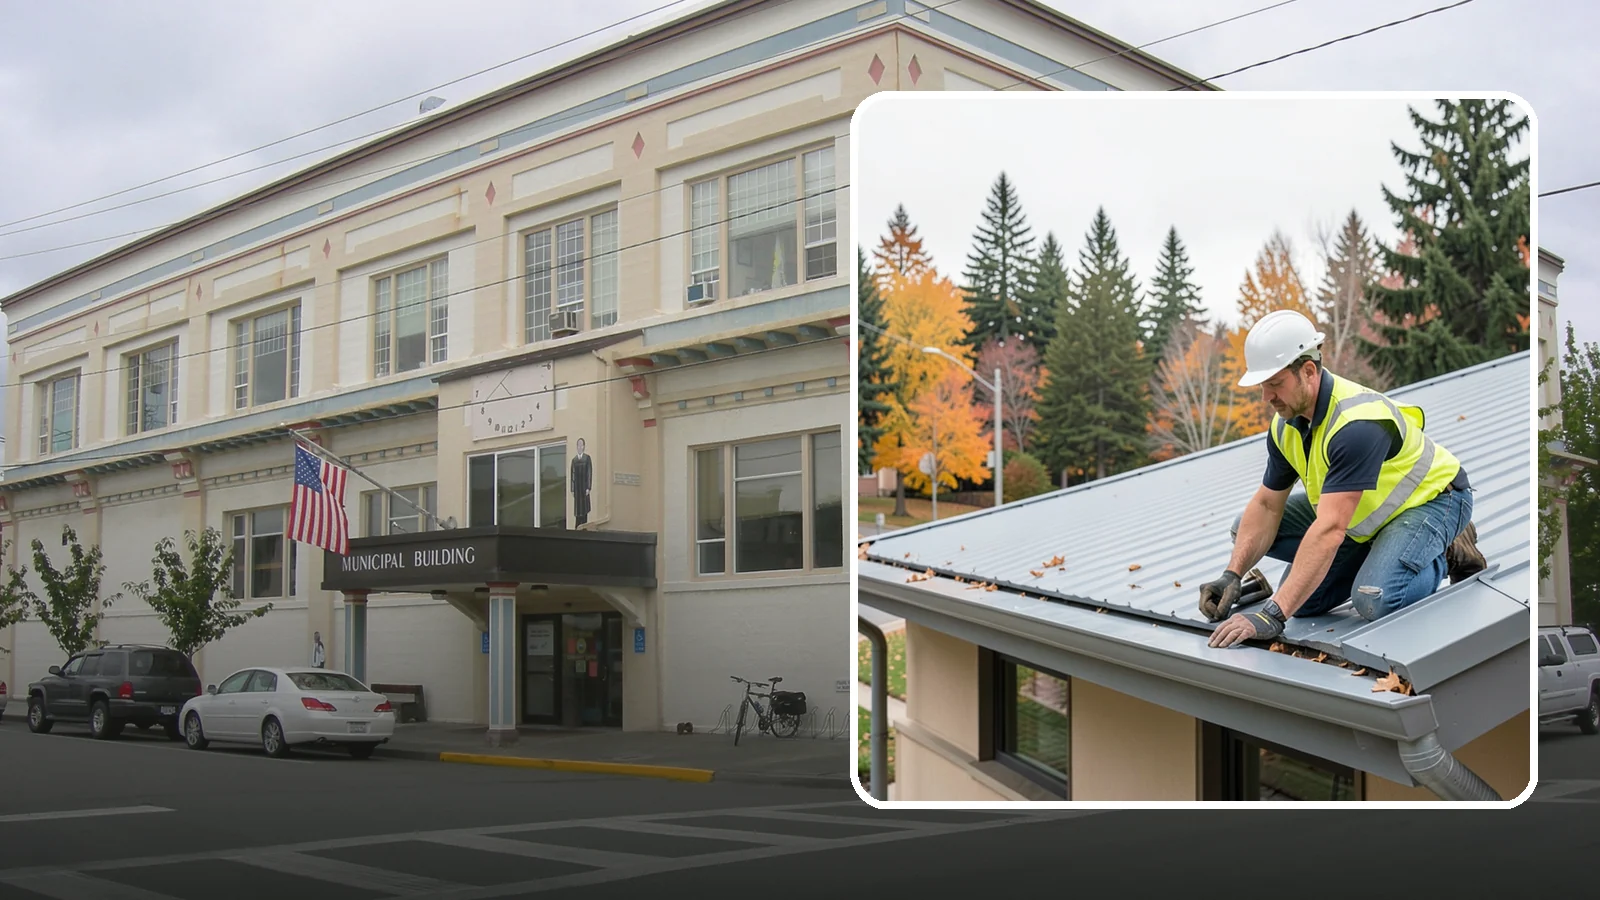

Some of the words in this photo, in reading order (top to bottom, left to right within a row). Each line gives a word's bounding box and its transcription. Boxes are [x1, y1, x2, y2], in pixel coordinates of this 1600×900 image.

[536, 402, 540, 410] 4
[488, 417, 492, 426] 9
[529, 414, 533, 422] 3
[494, 423, 500, 431] 10
[507, 425, 513, 433] 12
[521, 420, 525, 428] 2
[342, 552, 405, 571] MUNICIPAL
[415, 546, 475, 566] BUILDING
